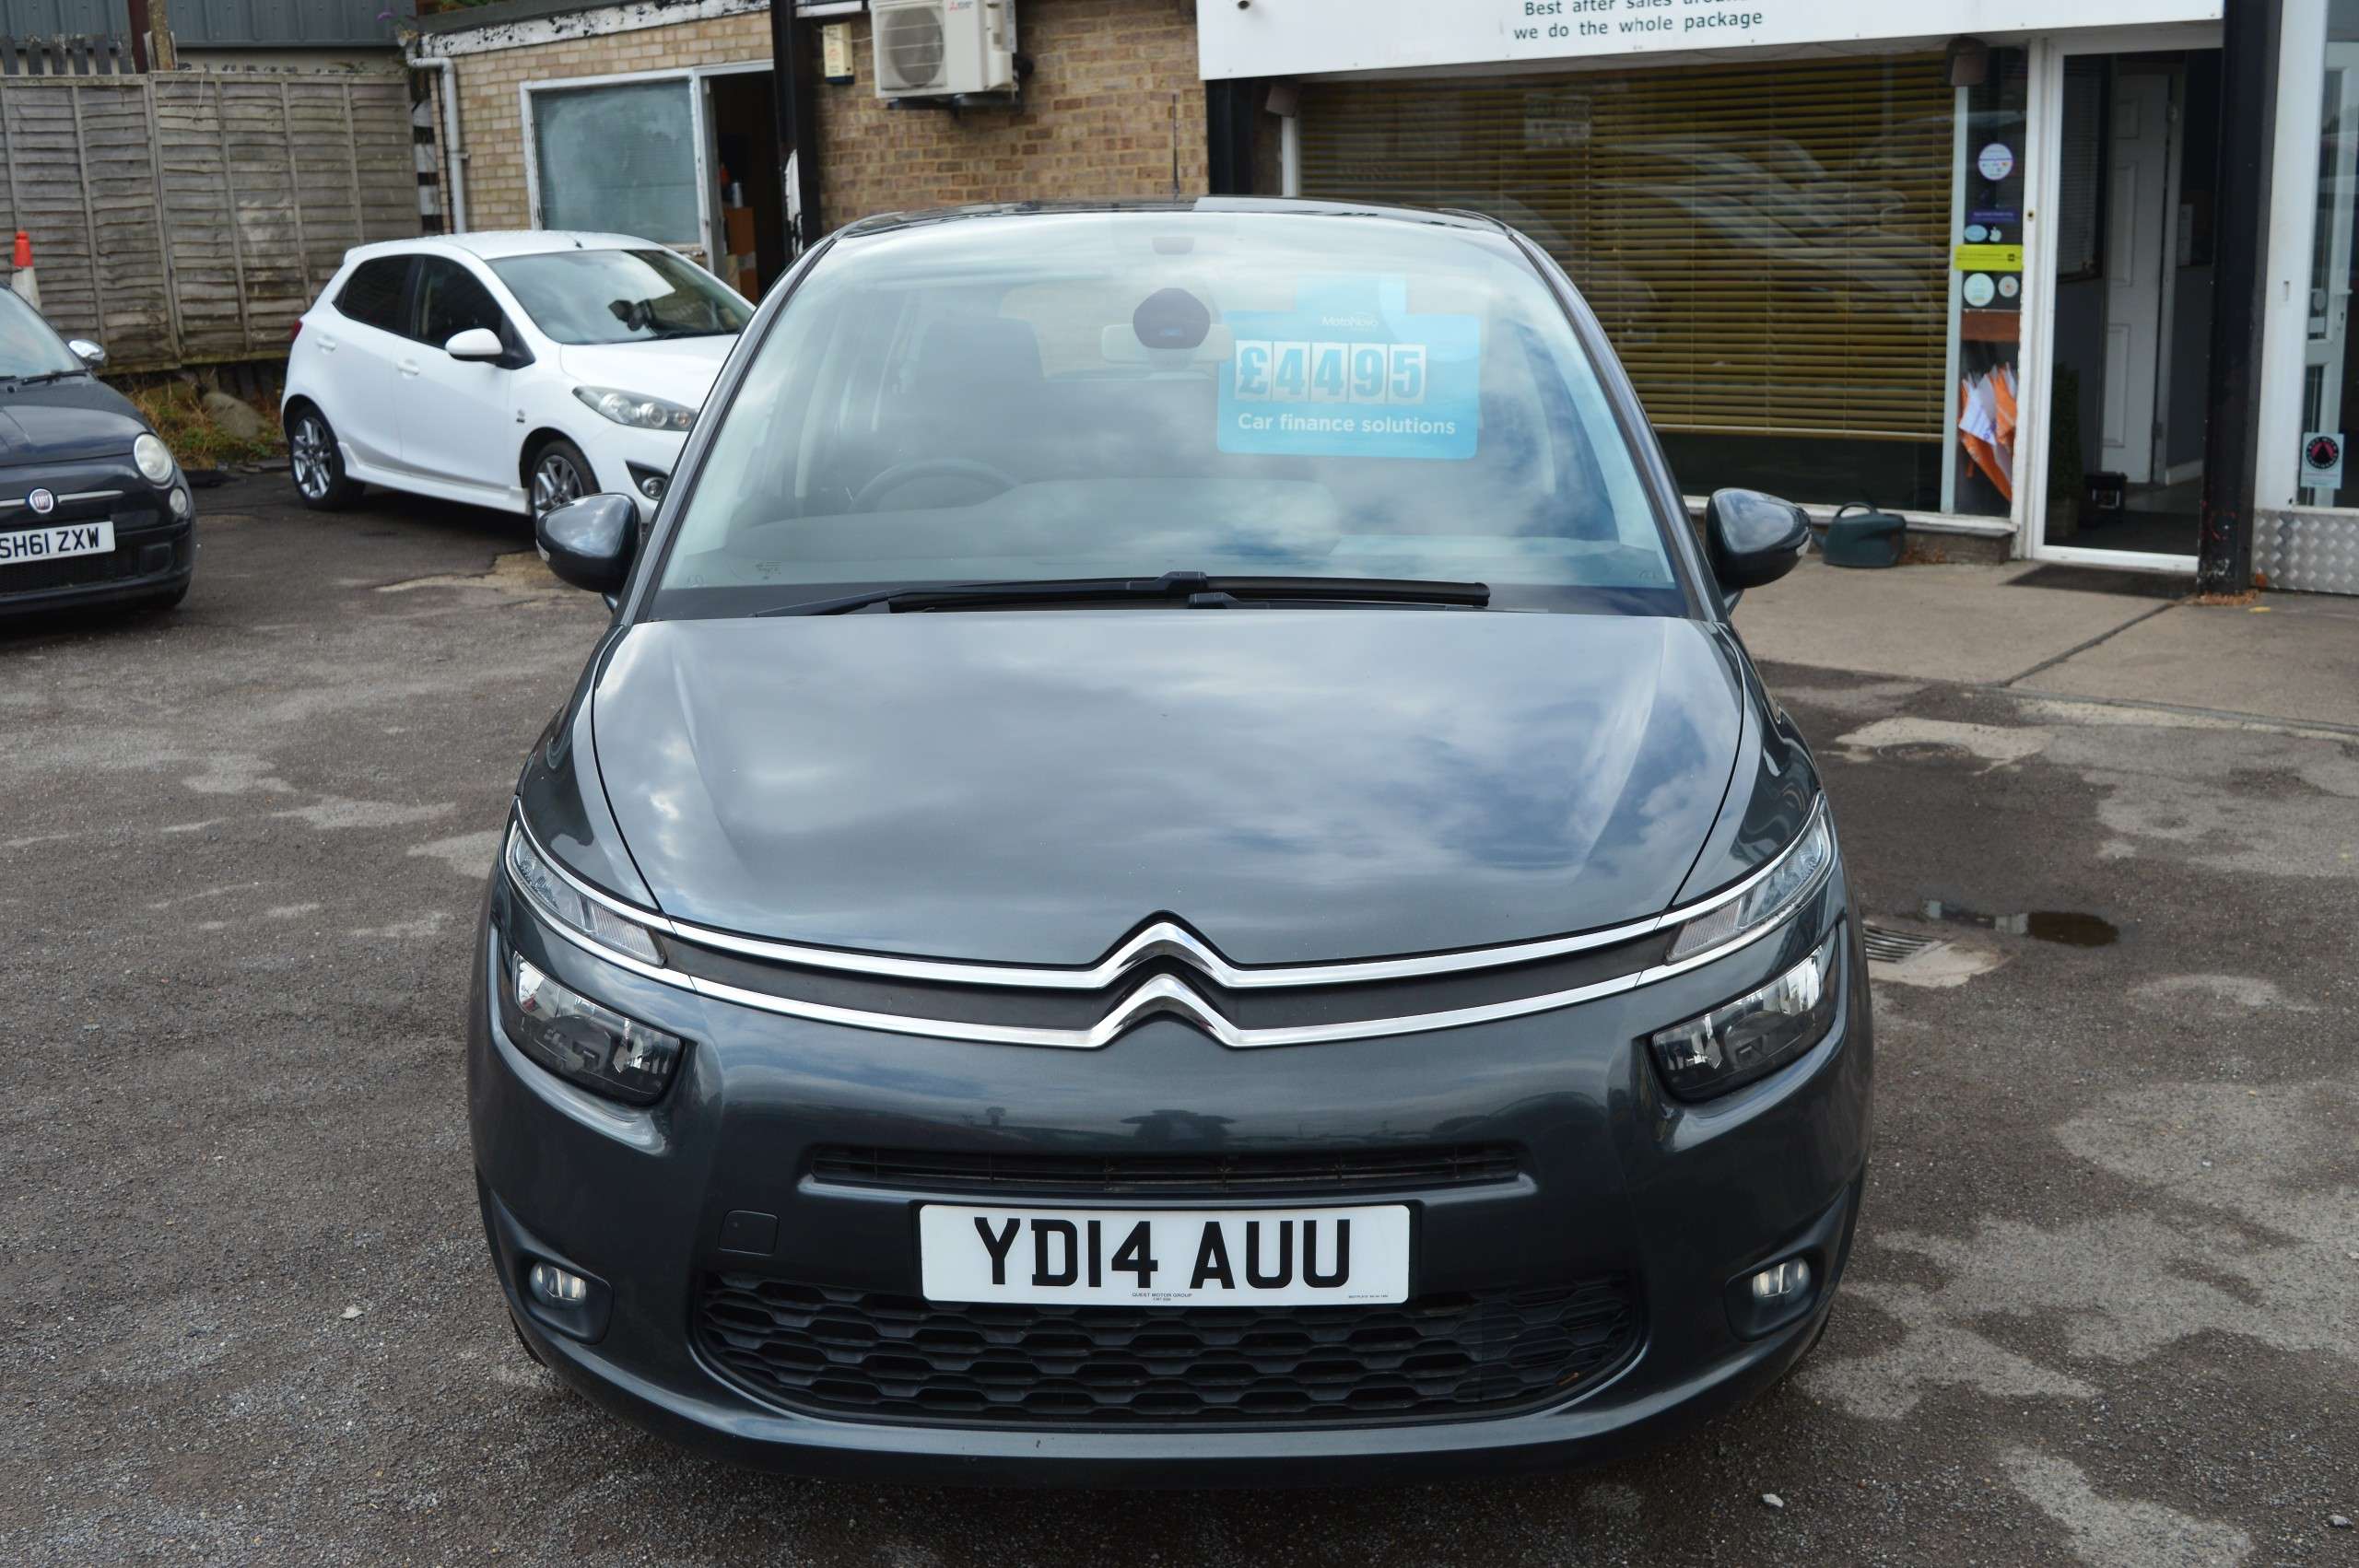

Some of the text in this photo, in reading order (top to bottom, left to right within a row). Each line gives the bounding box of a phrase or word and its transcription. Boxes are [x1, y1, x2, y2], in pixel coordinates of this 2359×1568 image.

[1524, 0, 1672, 16] Best after sales
[1514, 11, 1763, 40] we do the whole package
[1238, 346, 1423, 399] £4495
[1238, 413, 1456, 436] Car finance solutions
[0, 526, 100, 559] SH61 ZXW
[974, 1216, 1351, 1290] YD14 AUU
